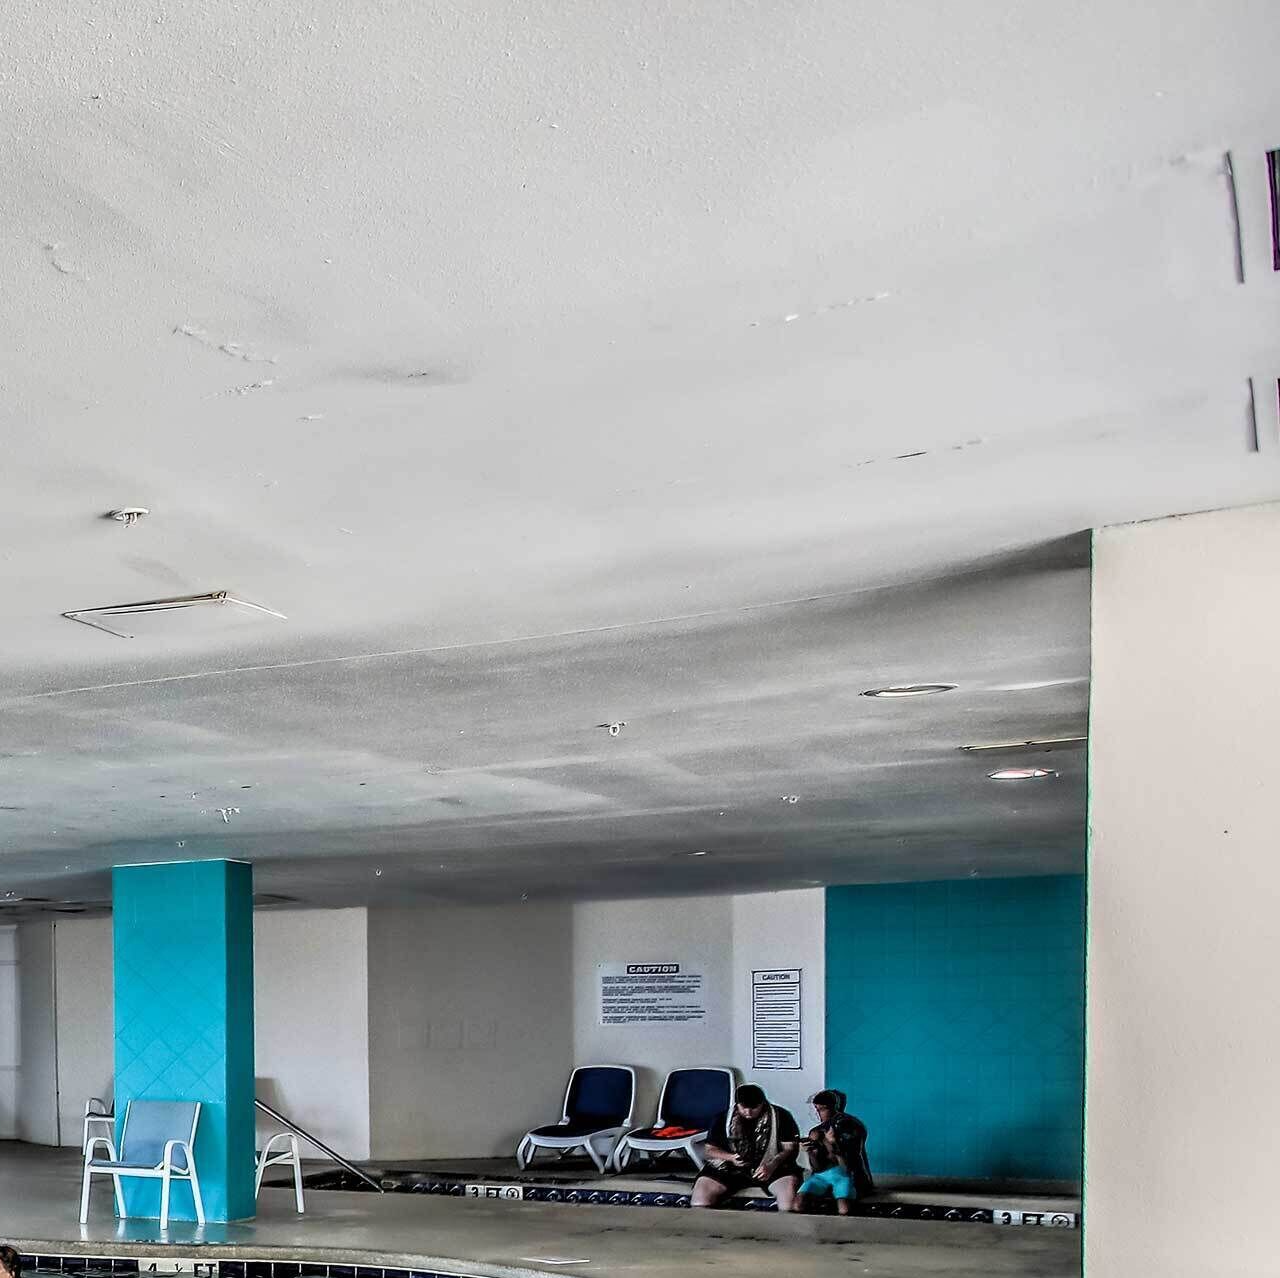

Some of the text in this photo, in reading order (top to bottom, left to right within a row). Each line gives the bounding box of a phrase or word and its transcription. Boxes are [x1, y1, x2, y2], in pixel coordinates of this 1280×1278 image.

[629, 966, 678, 974] CAUTION
[762, 973, 791, 981] CAUTION
[486, 1187, 502, 1198] FT
[1001, 1212, 1045, 1225] 3 FT
[193, 1263, 217, 1278] FT
